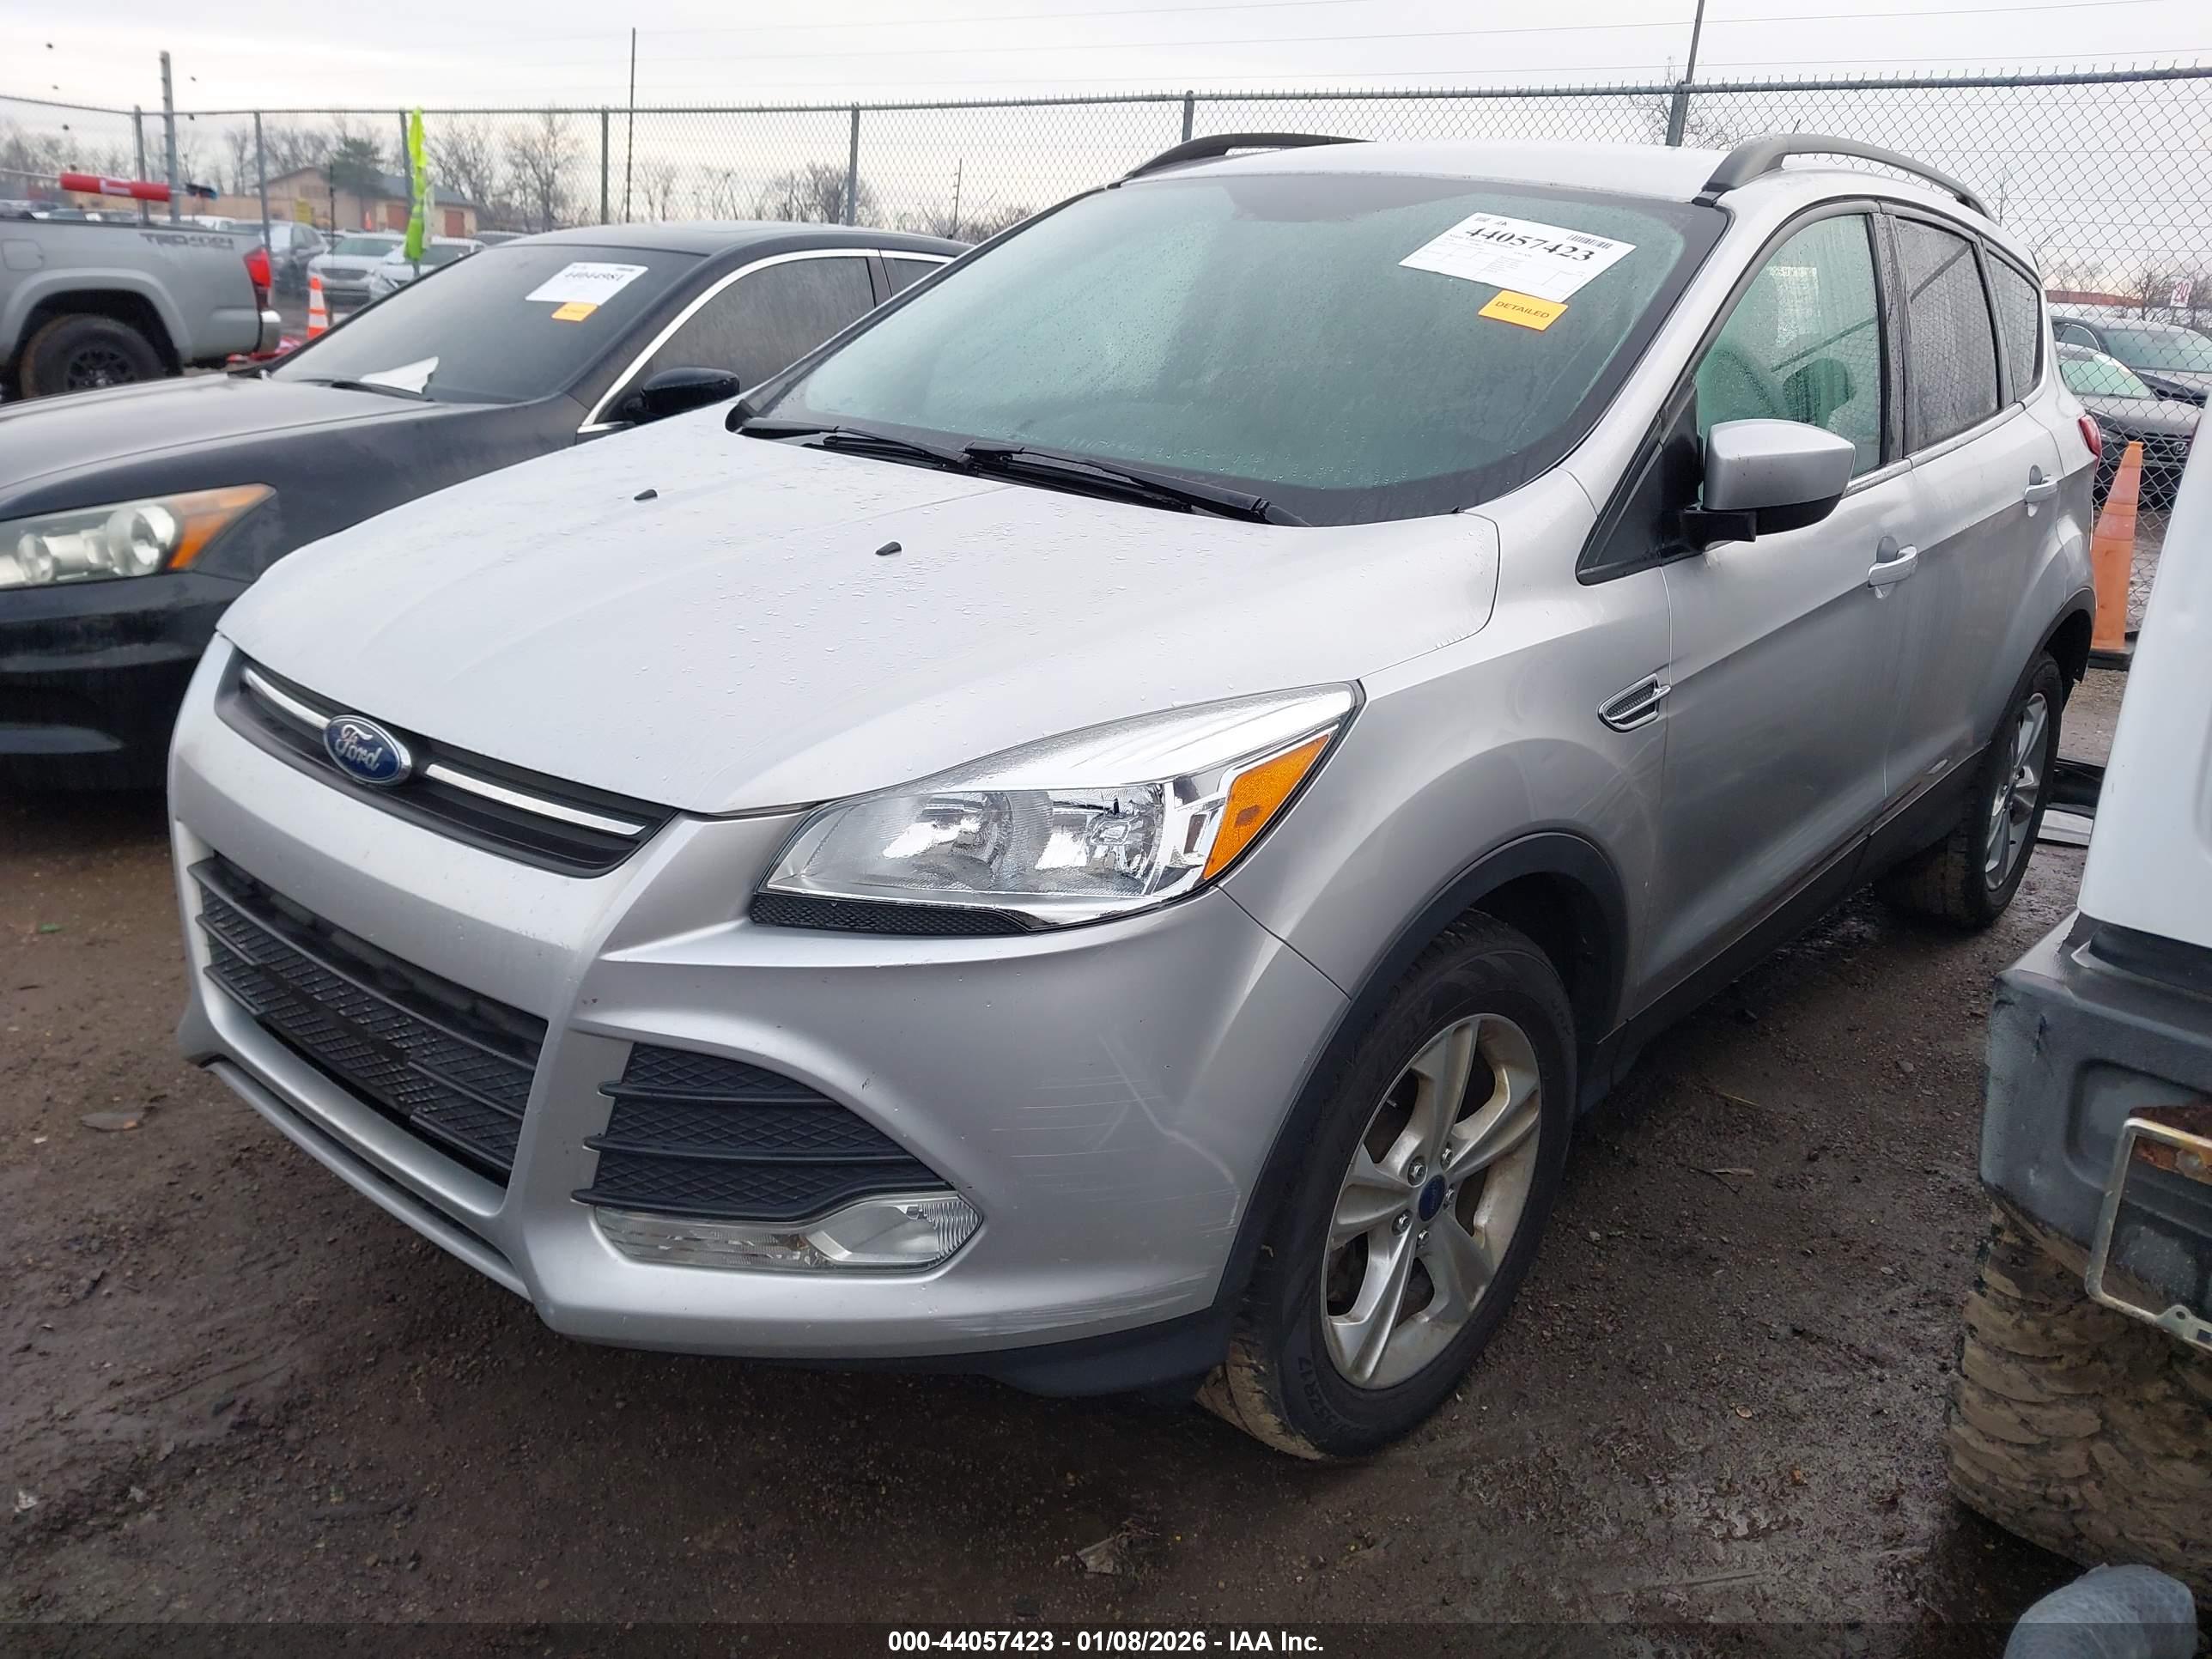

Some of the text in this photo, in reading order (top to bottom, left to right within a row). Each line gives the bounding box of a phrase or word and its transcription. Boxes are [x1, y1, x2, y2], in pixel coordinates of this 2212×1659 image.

[1466, 227, 1595, 262] 44057423
[1494, 300, 1551, 319] DETAILED
[334, 723, 383, 772] Ford
